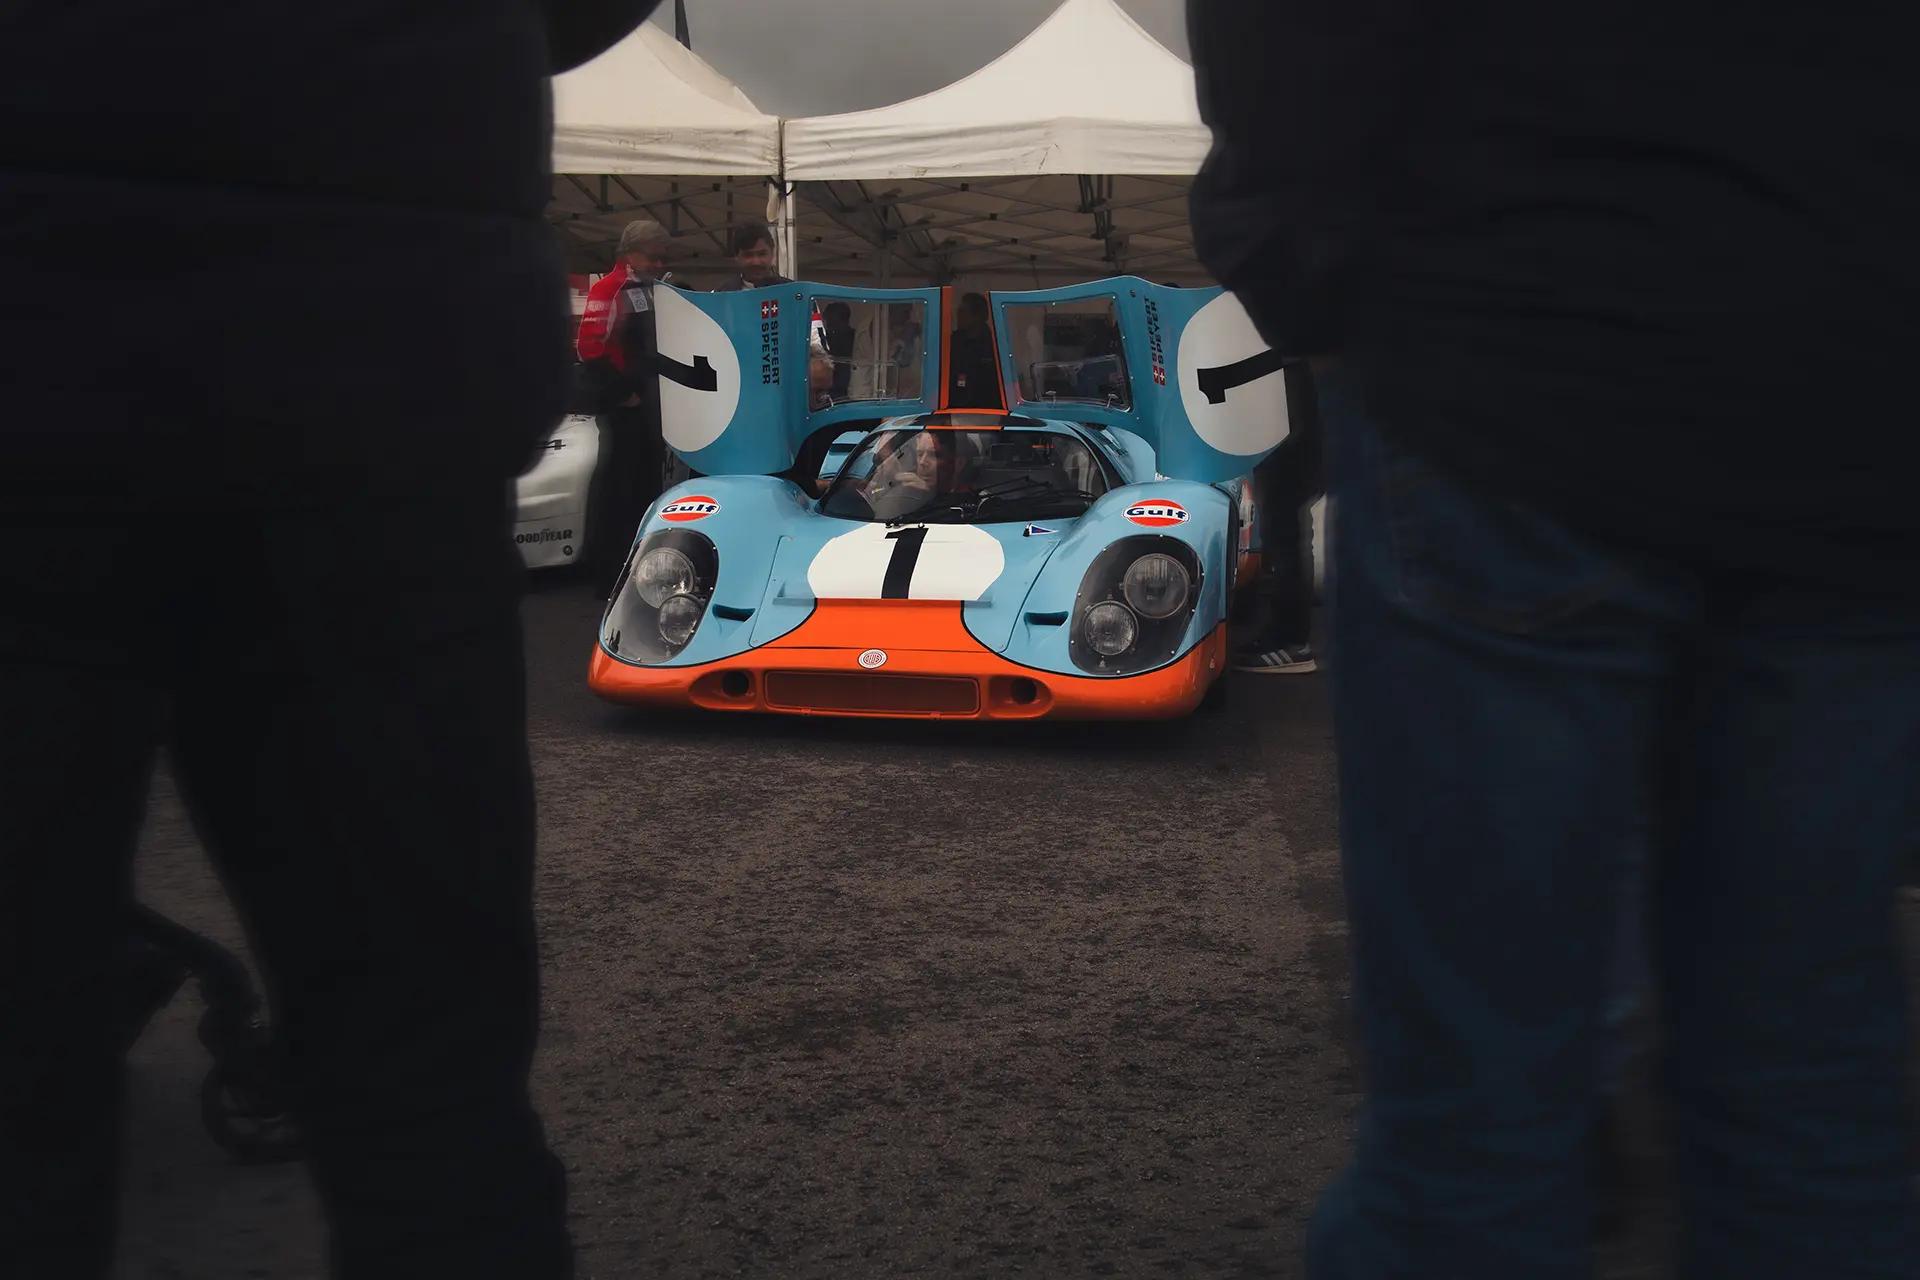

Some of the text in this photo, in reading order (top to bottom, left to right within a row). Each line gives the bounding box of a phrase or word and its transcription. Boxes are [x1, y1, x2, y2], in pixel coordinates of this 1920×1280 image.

[657, 352, 718, 392] 1
[761, 322, 771, 385] SPEYER
[770, 320, 780, 385] SIFFERT
[1197, 348, 1284, 405] 1
[662, 504, 717, 513] Gulf
[1126, 507, 1187, 519] Gulf
[513, 528, 573, 544] OODYEAR
[881, 528, 929, 599] 1
